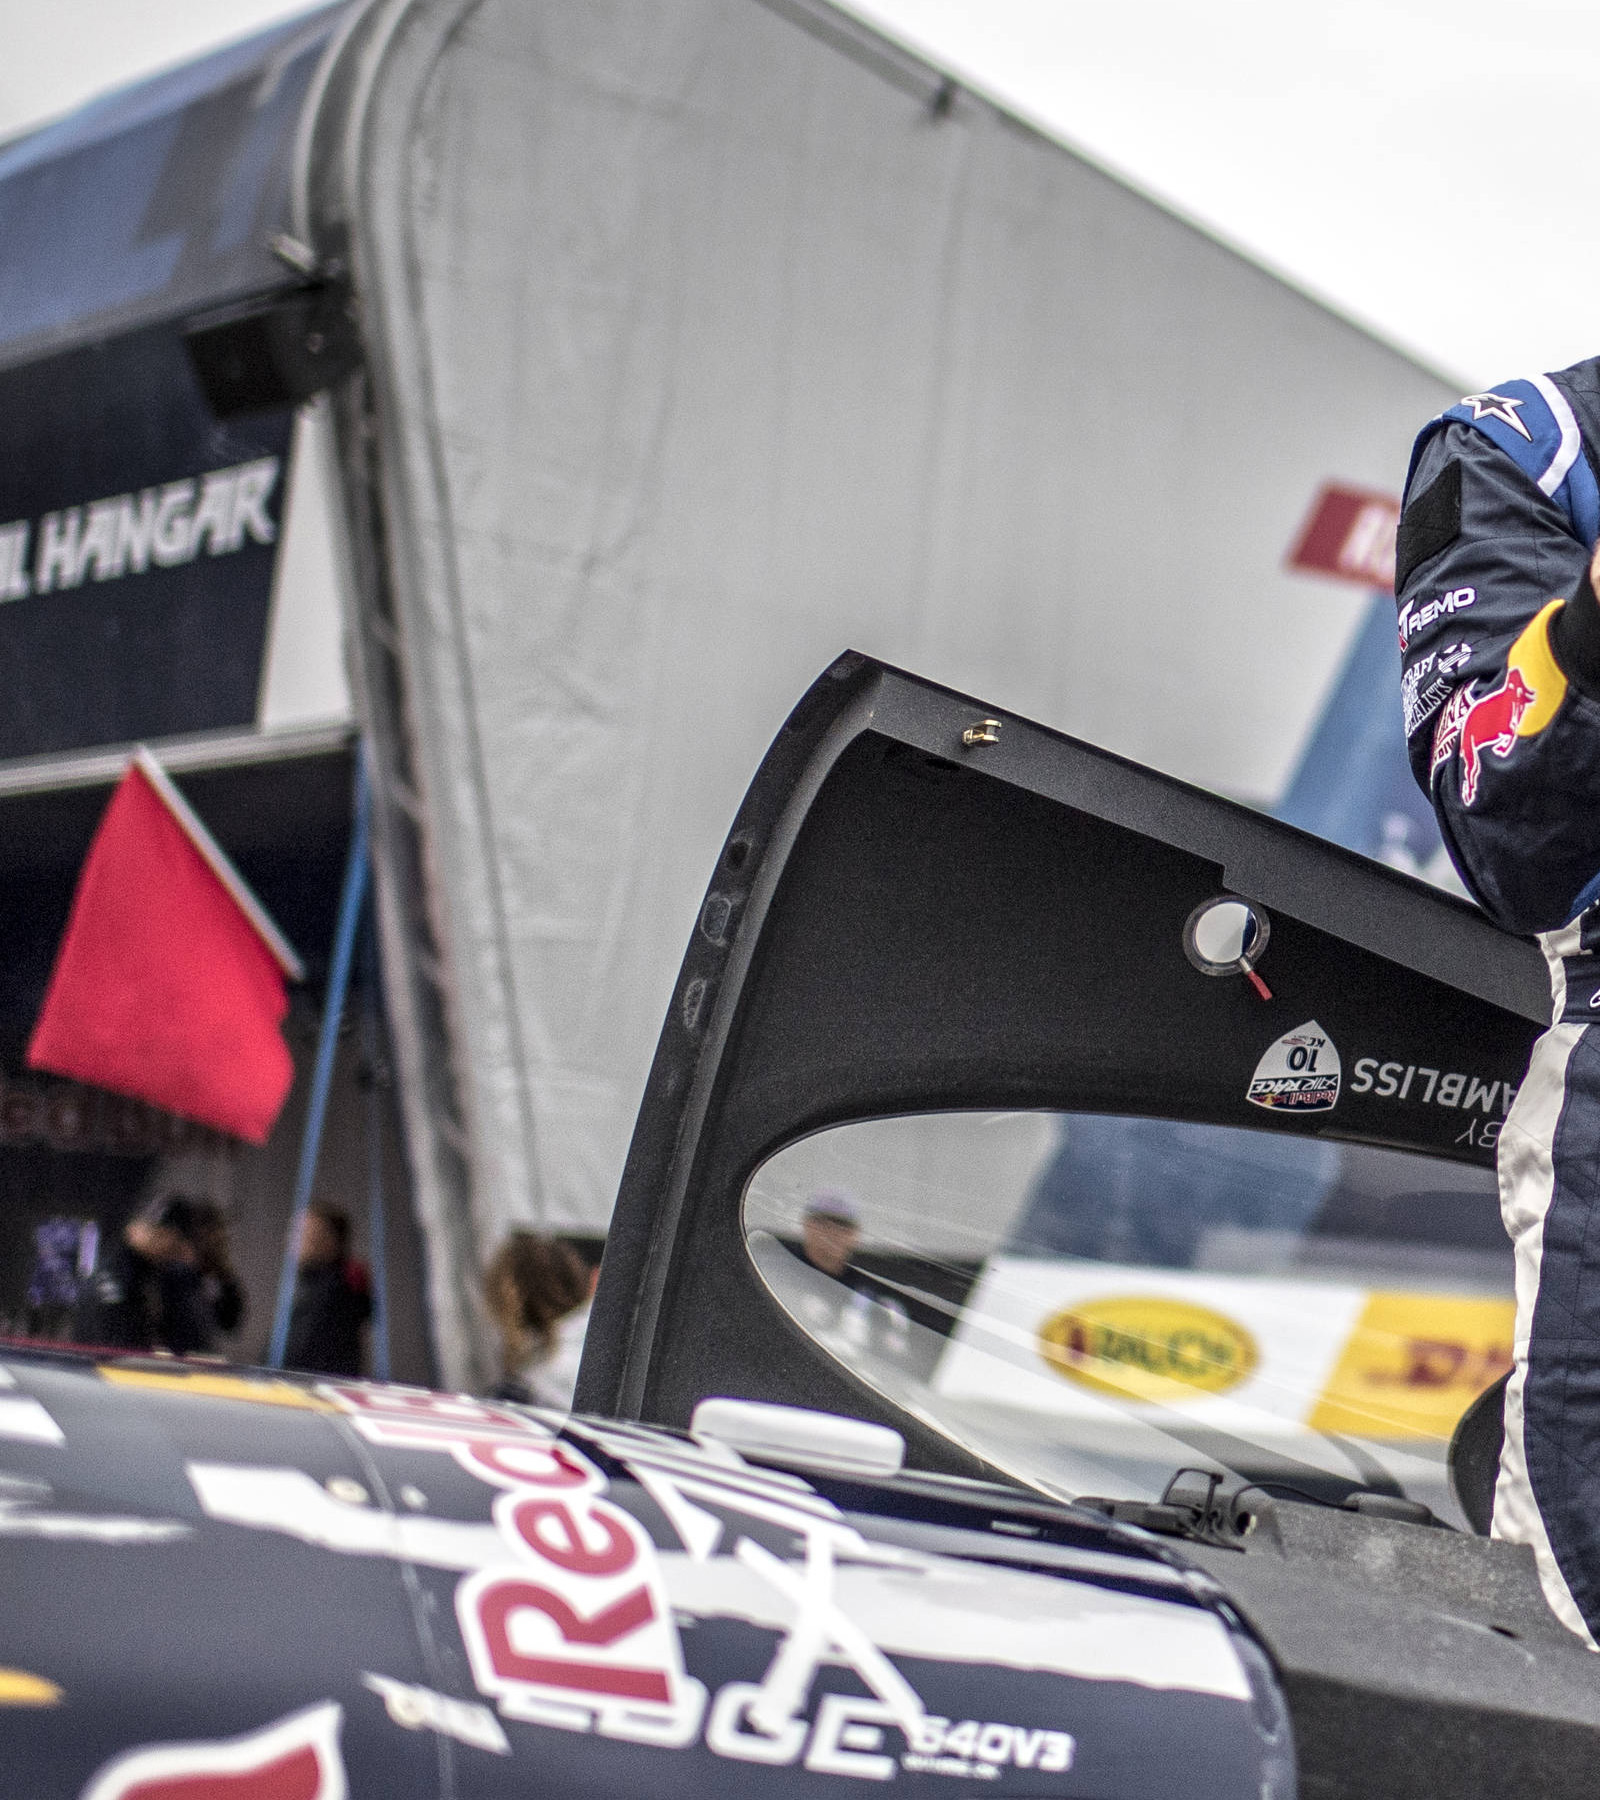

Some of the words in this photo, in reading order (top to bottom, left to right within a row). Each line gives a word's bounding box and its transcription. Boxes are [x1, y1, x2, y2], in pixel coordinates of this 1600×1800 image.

[36, 455, 279, 595] HANGAR
[1286, 1046, 1318, 1073] 10
[1252, 1079, 1304, 1095] RACE
[1289, 1091, 1314, 1105] Bull
[1313, 1090, 1336, 1104] Red
[1350, 1057, 1518, 1116] AMBLISS
[1455, 1118, 1503, 1148] BY
[352, 1412, 690, 1708] Red
